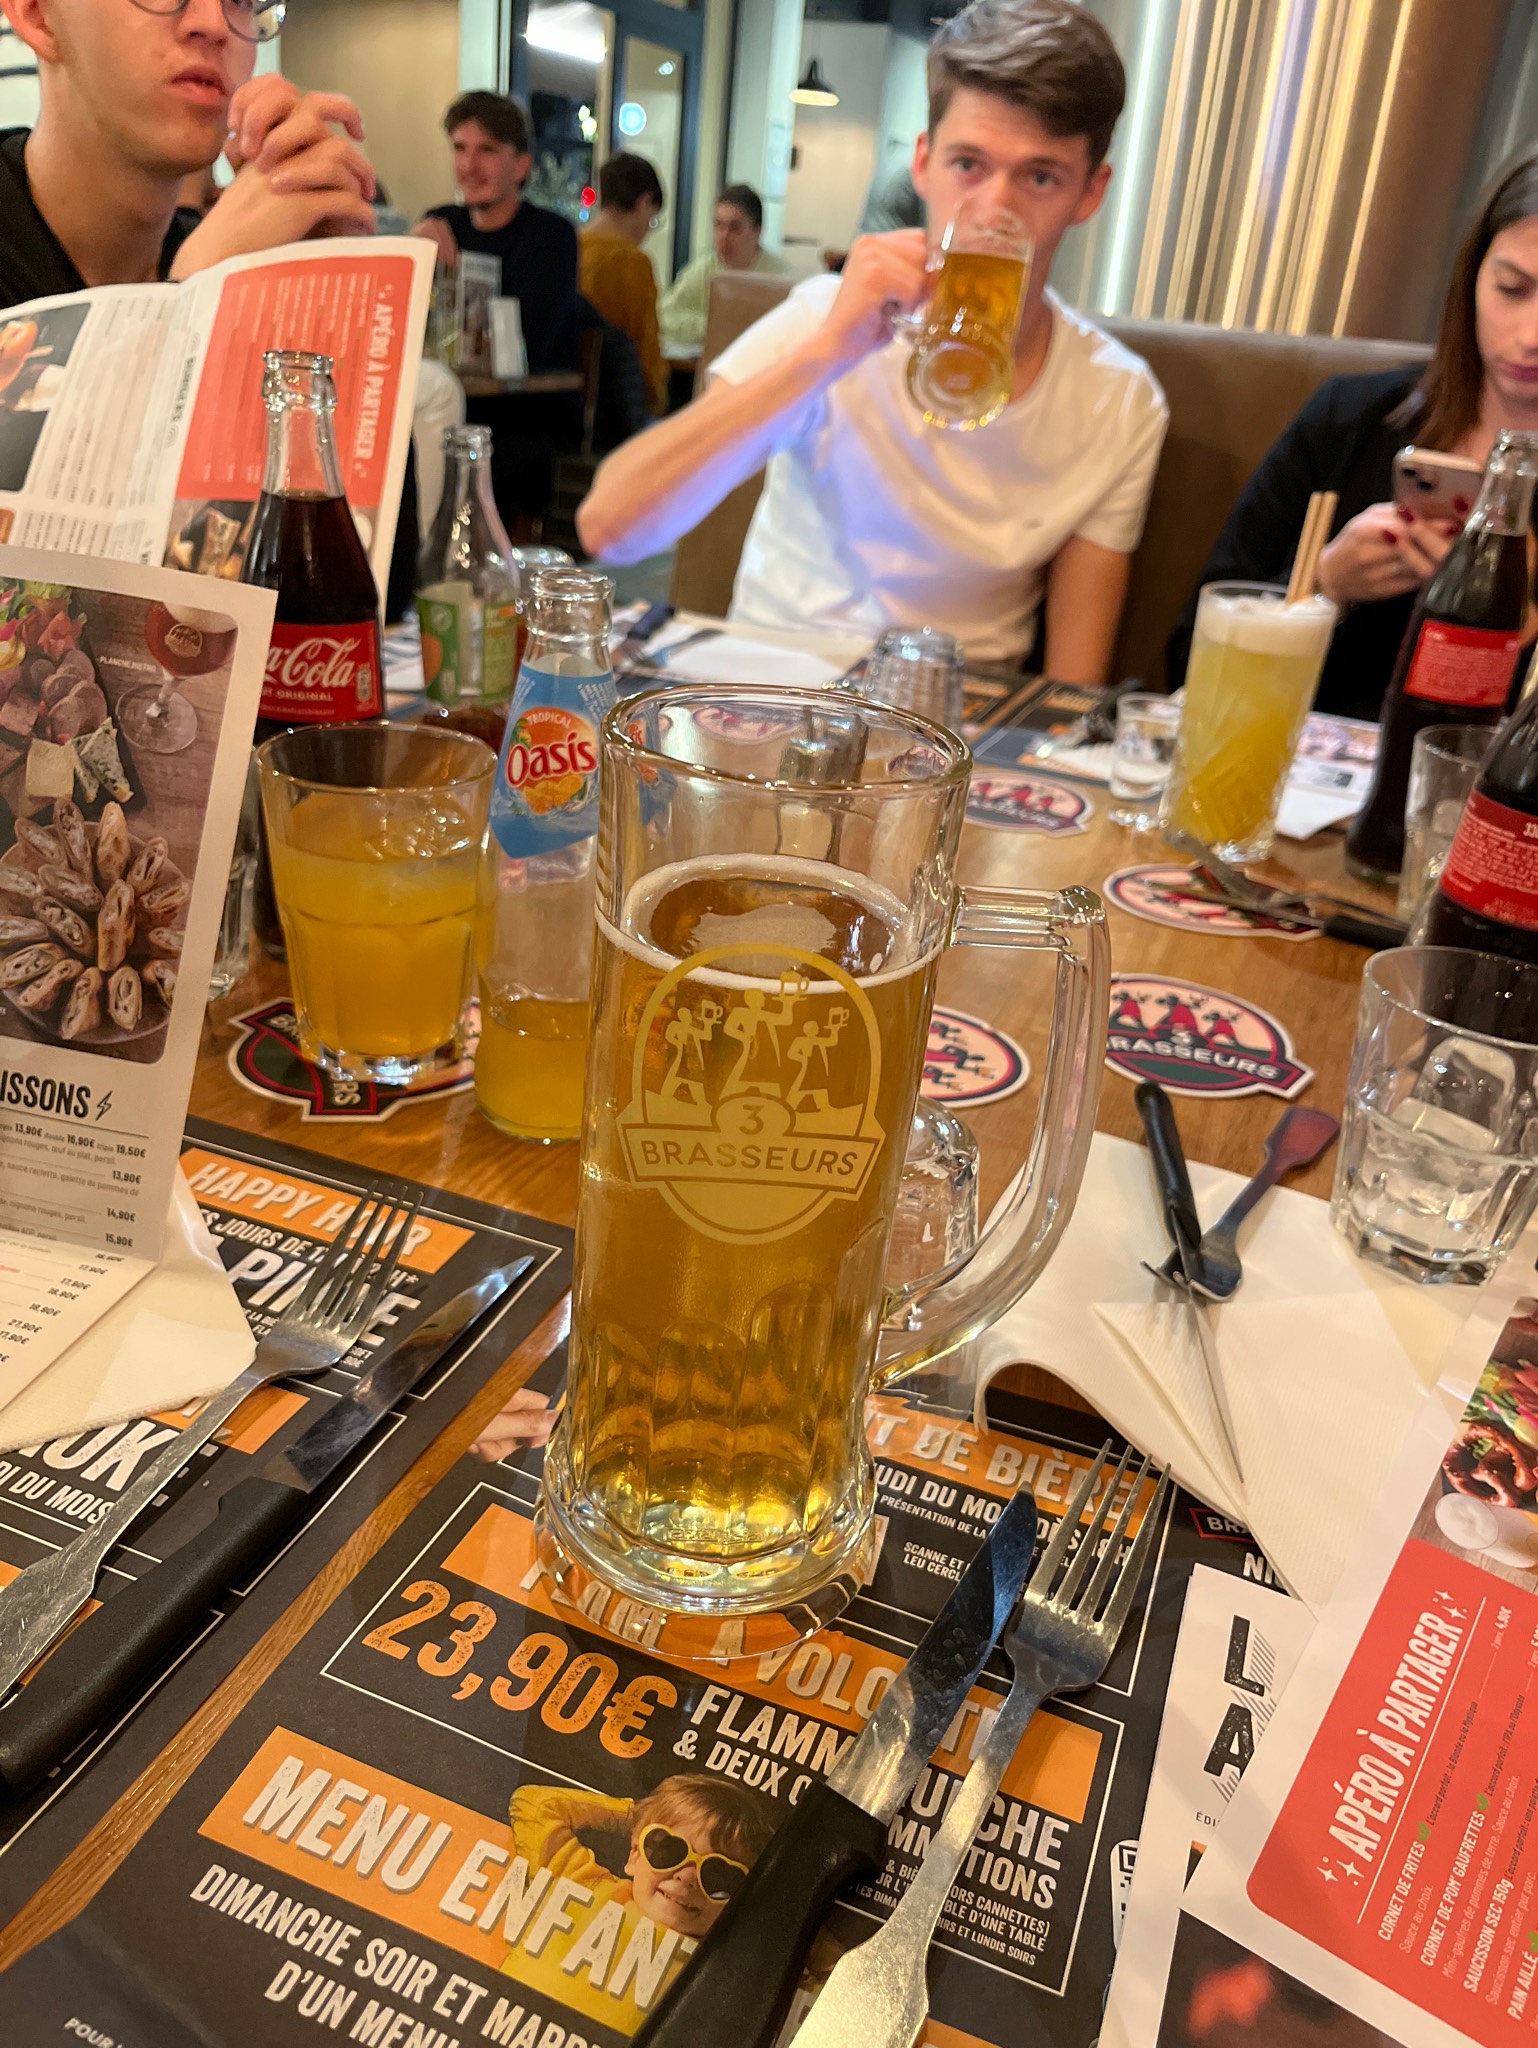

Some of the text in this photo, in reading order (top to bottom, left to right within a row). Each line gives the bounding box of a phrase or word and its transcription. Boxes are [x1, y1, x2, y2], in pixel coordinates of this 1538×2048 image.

[277, 690, 334, 702] ORIGINAL
[527, 711, 572, 729] TROPICAL
[505, 732, 599, 789] Oasis
[1105, 1035, 1281, 1080] RASSEURS
[15, 1122, 43, 1138] 13,90€
[739, 1104, 764, 1136] 3
[112, 1169, 142, 1185] 13,90€
[640, 1140, 859, 1176] BRASSEURS
[188, 1162, 326, 1221] HAPPY
[214, 1216, 284, 1250] JOURS
[278, 1236, 313, 1258] DE
[911, 1423, 980, 1474] DE
[8, 1470, 58, 1501] DU
[44, 1484, 118, 1526] MOIS
[879, 1494, 987, 1540] PRÉSENTATION DE LA
[919, 1480, 959, 1509] DU
[960, 1493, 1004, 1525] MO
[903, 1541, 965, 1571] SCANNE ET
[926, 1562, 963, 1583] CERCL
[361, 1579, 679, 1760] 23,90€
[1328, 1611, 1464, 1863] APÉRO À PARTAGER
[672, 1728, 697, 1760] &
[705, 1741, 791, 1798] DEUX
[1491, 1808, 1509, 1835] Sauce
[1502, 1797, 1513, 1811] au
[1401, 1840, 1426, 1881] FRITES
[1480, 1855, 1493, 1870] de
[242, 1755, 699, 2010] MENU ENFAN
[1395, 1877, 1412, 1897] DE
[1420, 1917, 1447, 1967] CORNET
[1436, 1901, 1454, 1921] DE
[1452, 1810, 1486, 1878] GAUFRETTES
[1469, 1869, 1489, 1909] pommes
[1492, 1878, 1515, 1905] 150g
[968, 1910, 1047, 1952] D'UNE TABLE
[975, 1895, 1051, 1937] CANNETTES)
[1377, 1892, 1406, 1942] CORNET
[1399, 1884, 1435, 1954] Sauce au choix.
[1463, 1906, 1476, 1920] de
[1484, 1902, 1503, 1928] SEC
[189, 1863, 362, 1968] DIMANCHE
[354, 1938, 439, 2005] SOIR
[432, 1973, 489, 2025] ET
[957, 1925, 971, 1938] ET
[971, 1930, 1007, 1953] LUNDIS
[1007, 1945, 1037, 1967] SOIRS
[1463, 1924, 1496, 1993] SAUCISSON
[264, 1959, 358, 2033] D'UN
[1507, 1985, 1529, 2021] PAIN
